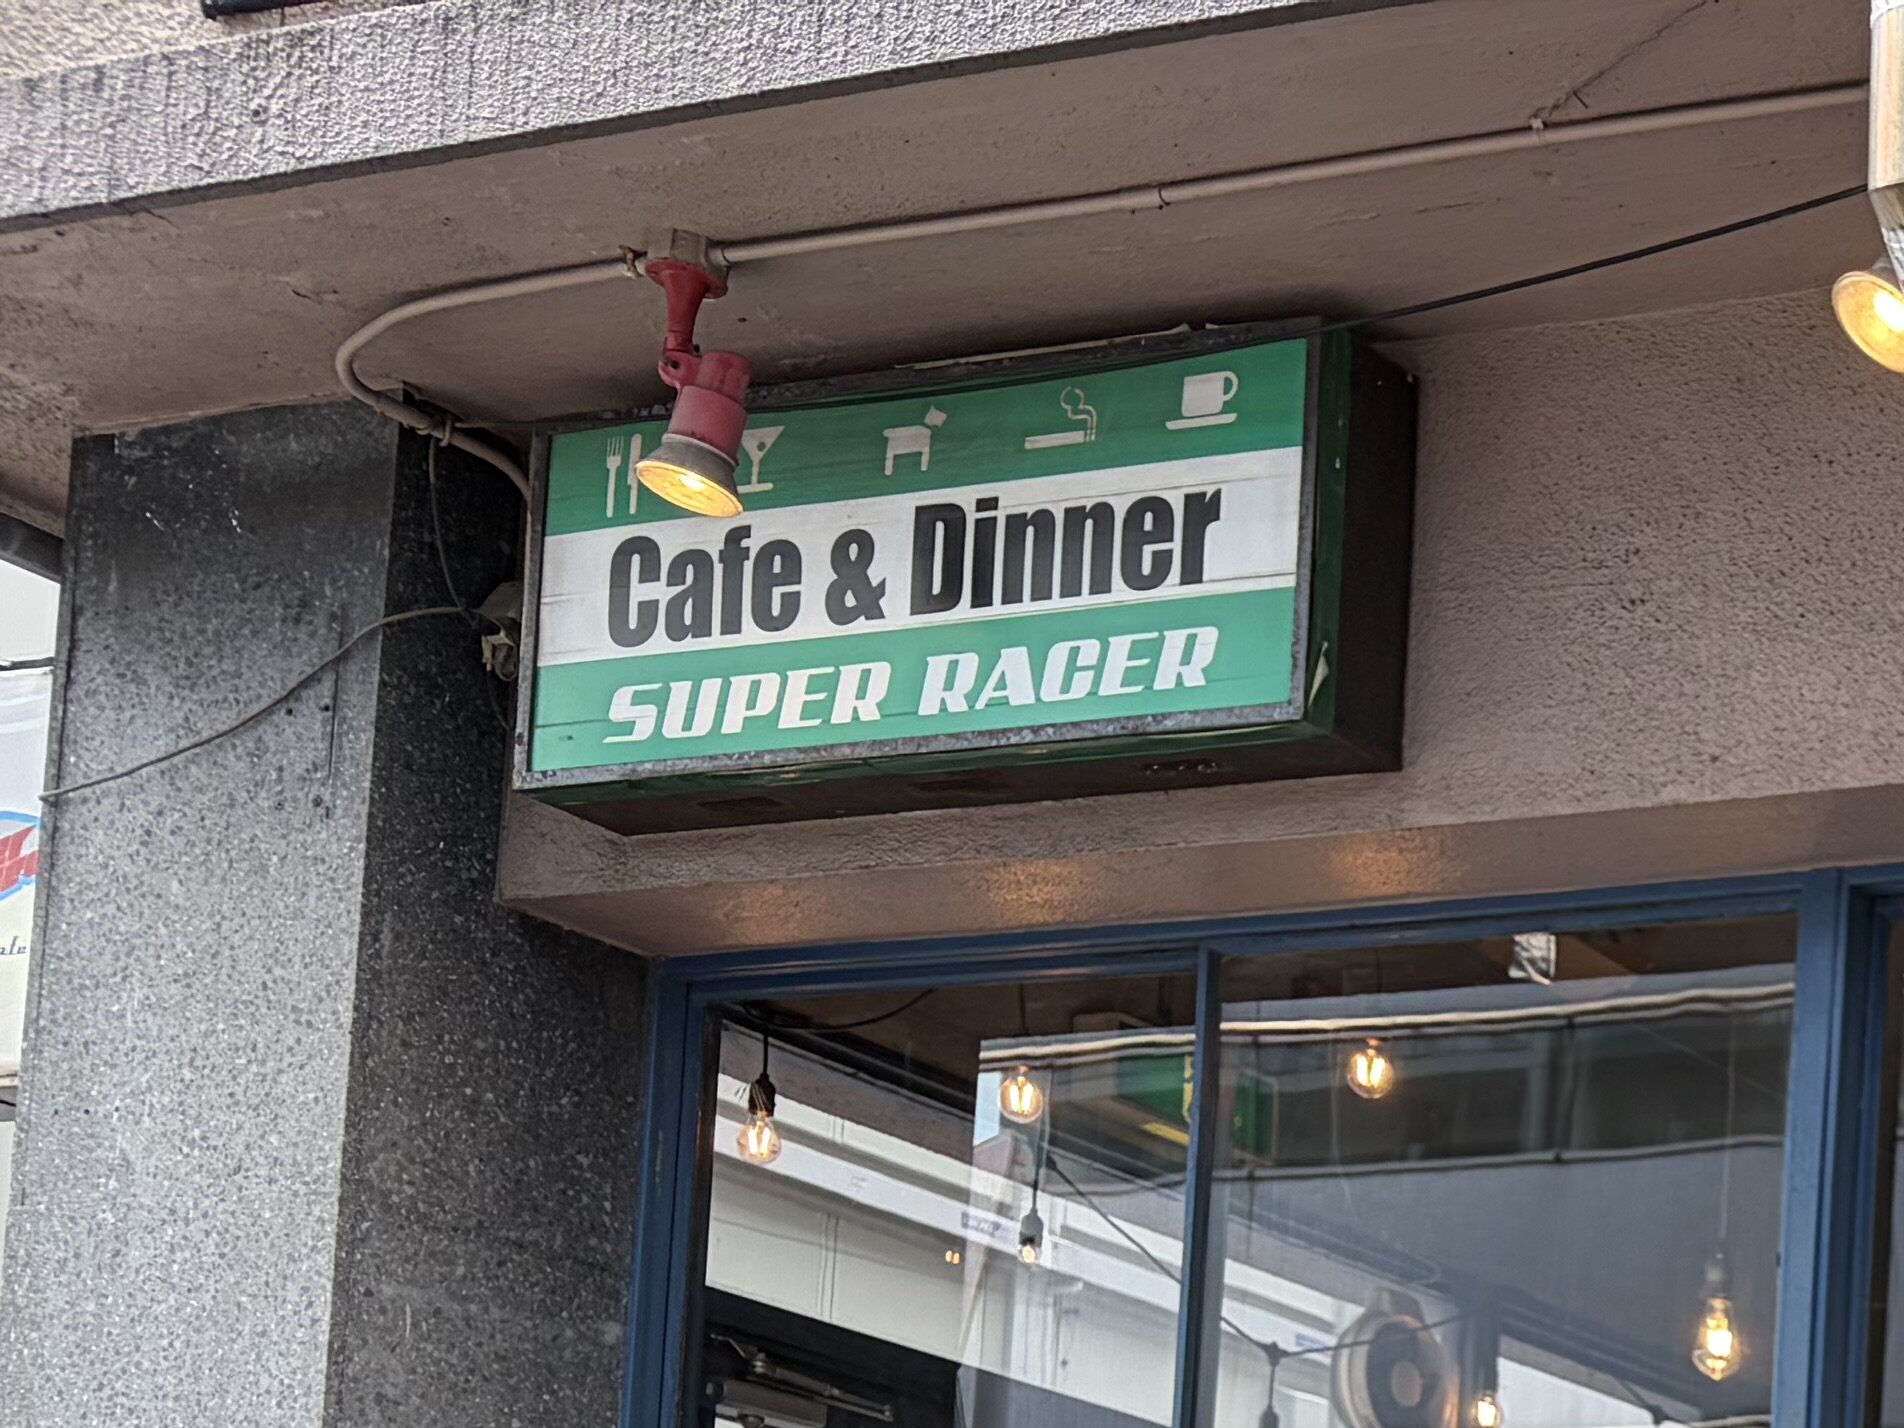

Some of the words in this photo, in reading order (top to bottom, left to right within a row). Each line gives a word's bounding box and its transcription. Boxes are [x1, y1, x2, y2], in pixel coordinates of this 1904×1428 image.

[606, 524, 802, 648] Cafe
[824, 528, 887, 626] &
[909, 488, 1222, 616] Dinner
[602, 660, 892, 744] SUPER
[917, 625, 1220, 717] RACER
